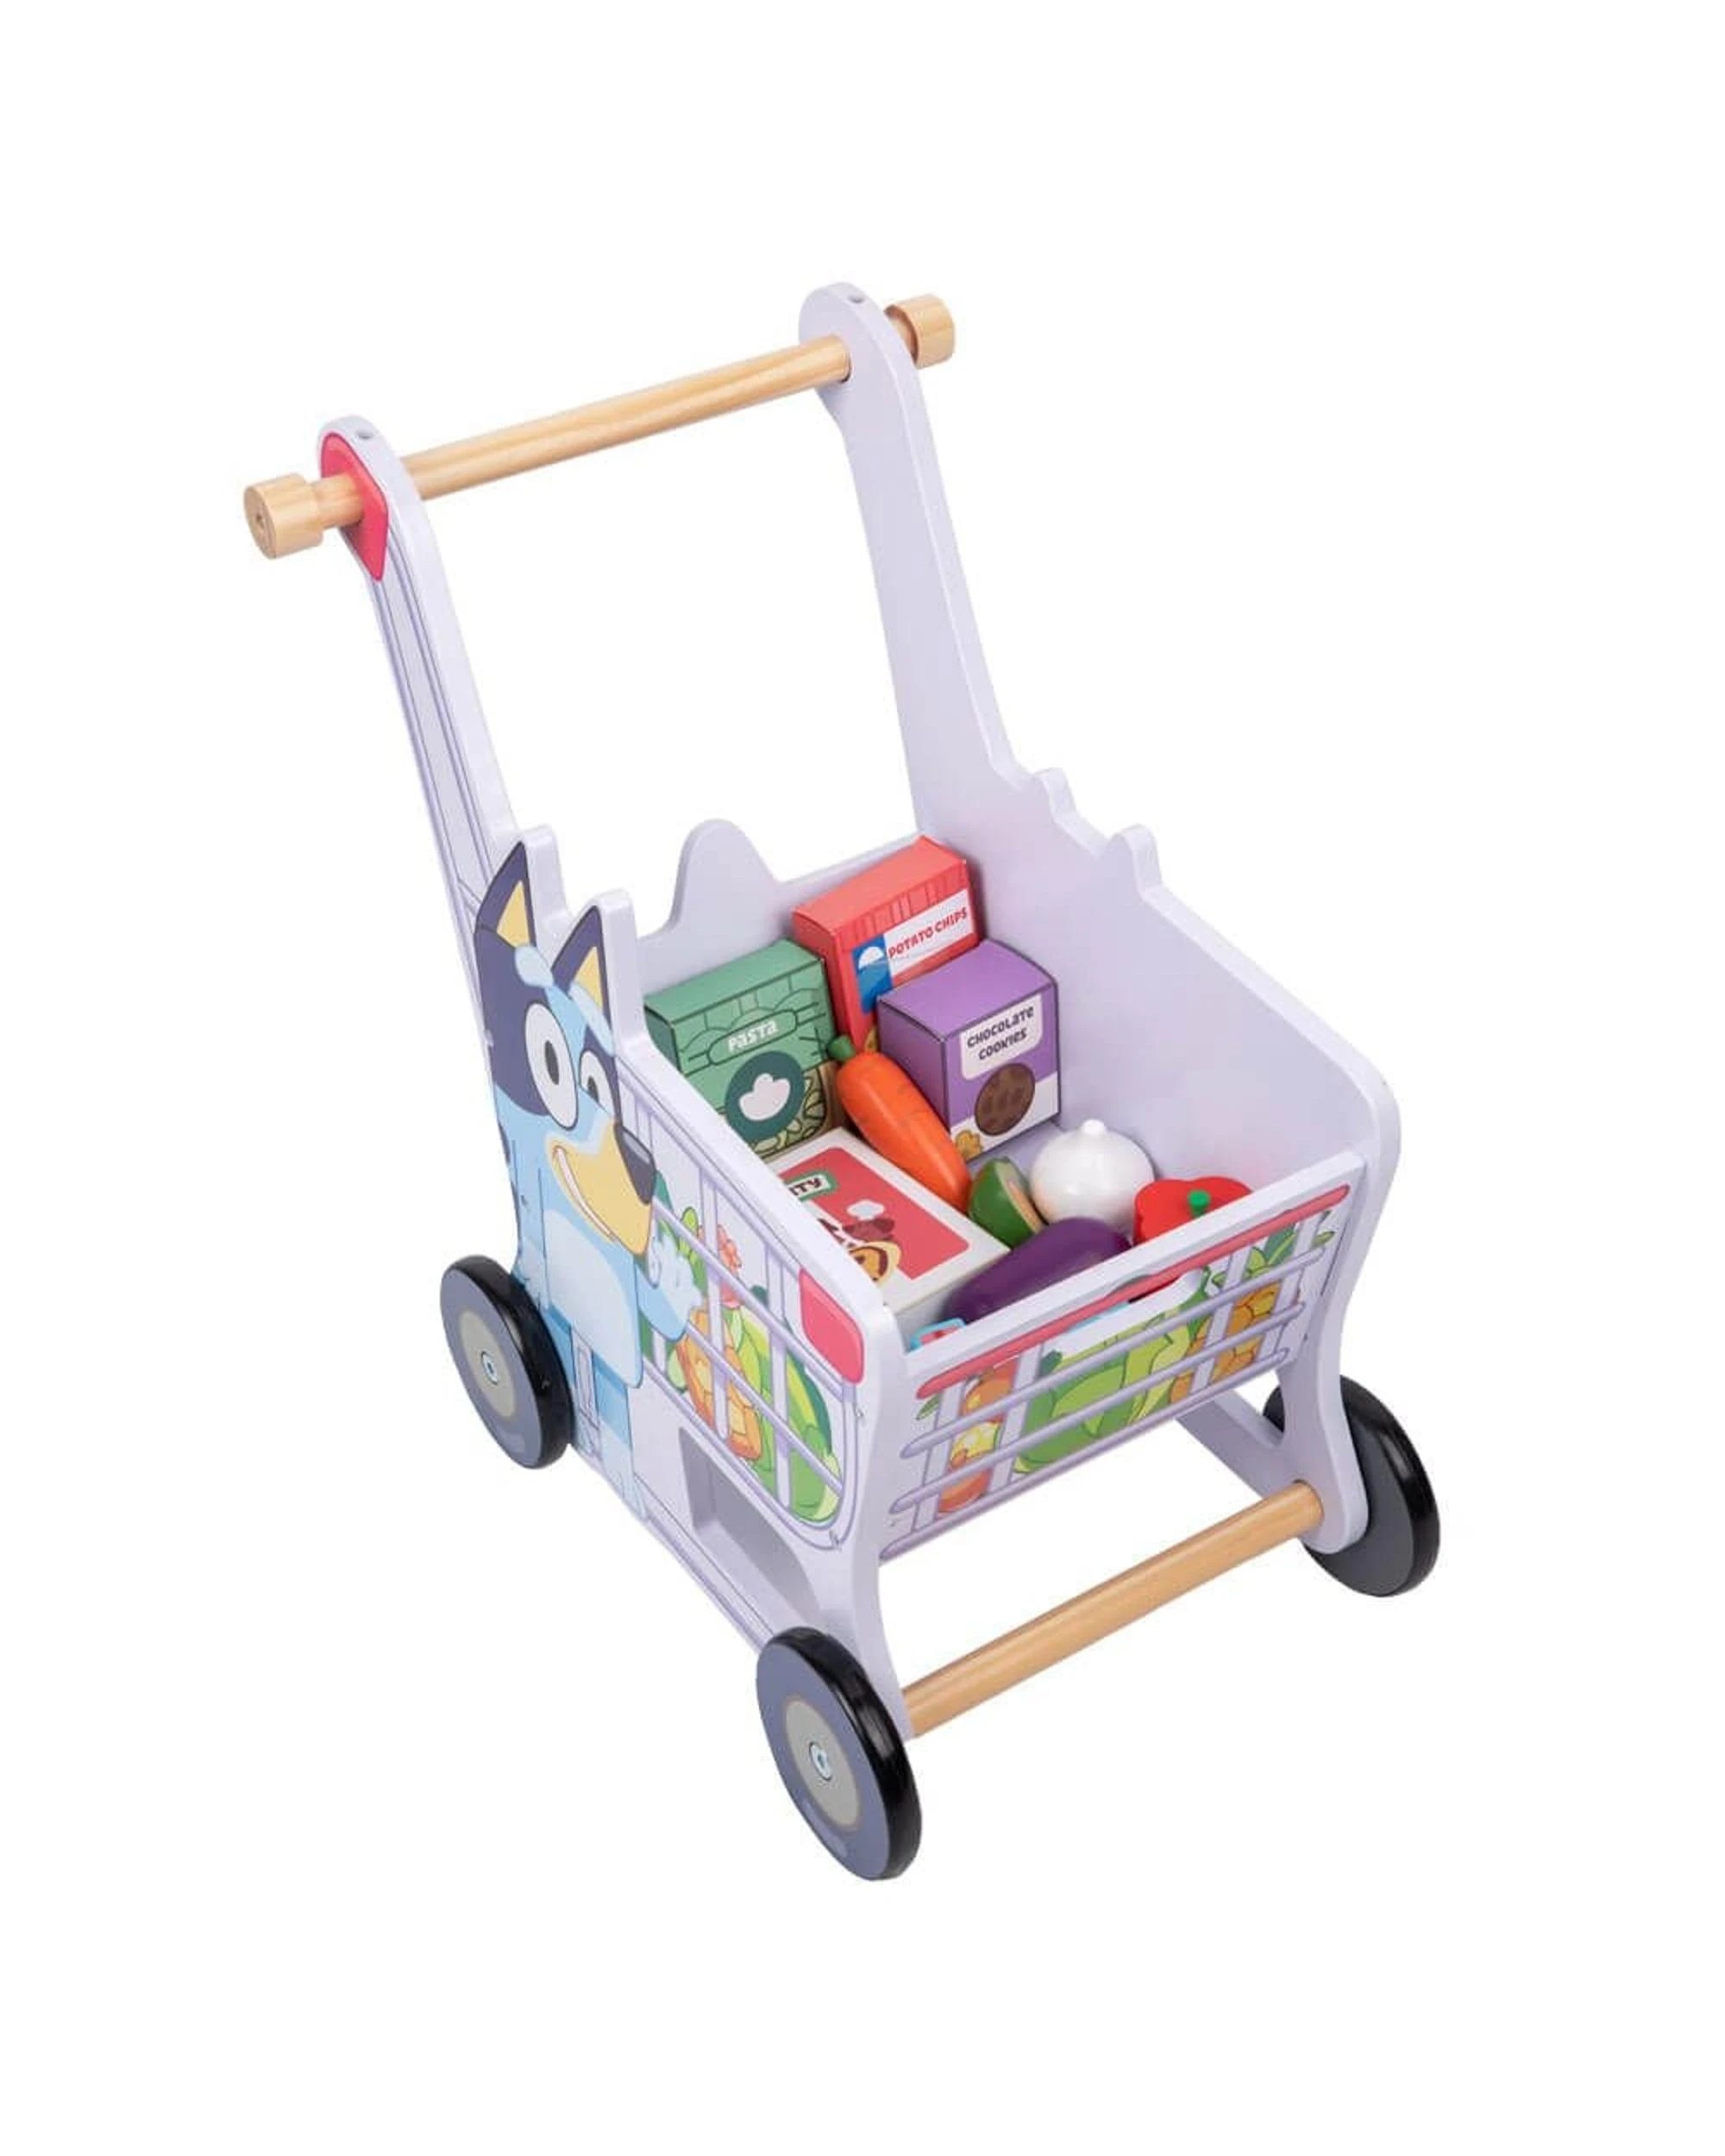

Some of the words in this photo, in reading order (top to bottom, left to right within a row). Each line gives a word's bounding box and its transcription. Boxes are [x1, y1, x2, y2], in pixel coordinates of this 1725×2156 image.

[888, 927, 933, 958] POTATO
[935, 907, 967, 933] CHIPS
[978, 1027, 1027, 1060] COOKIES
